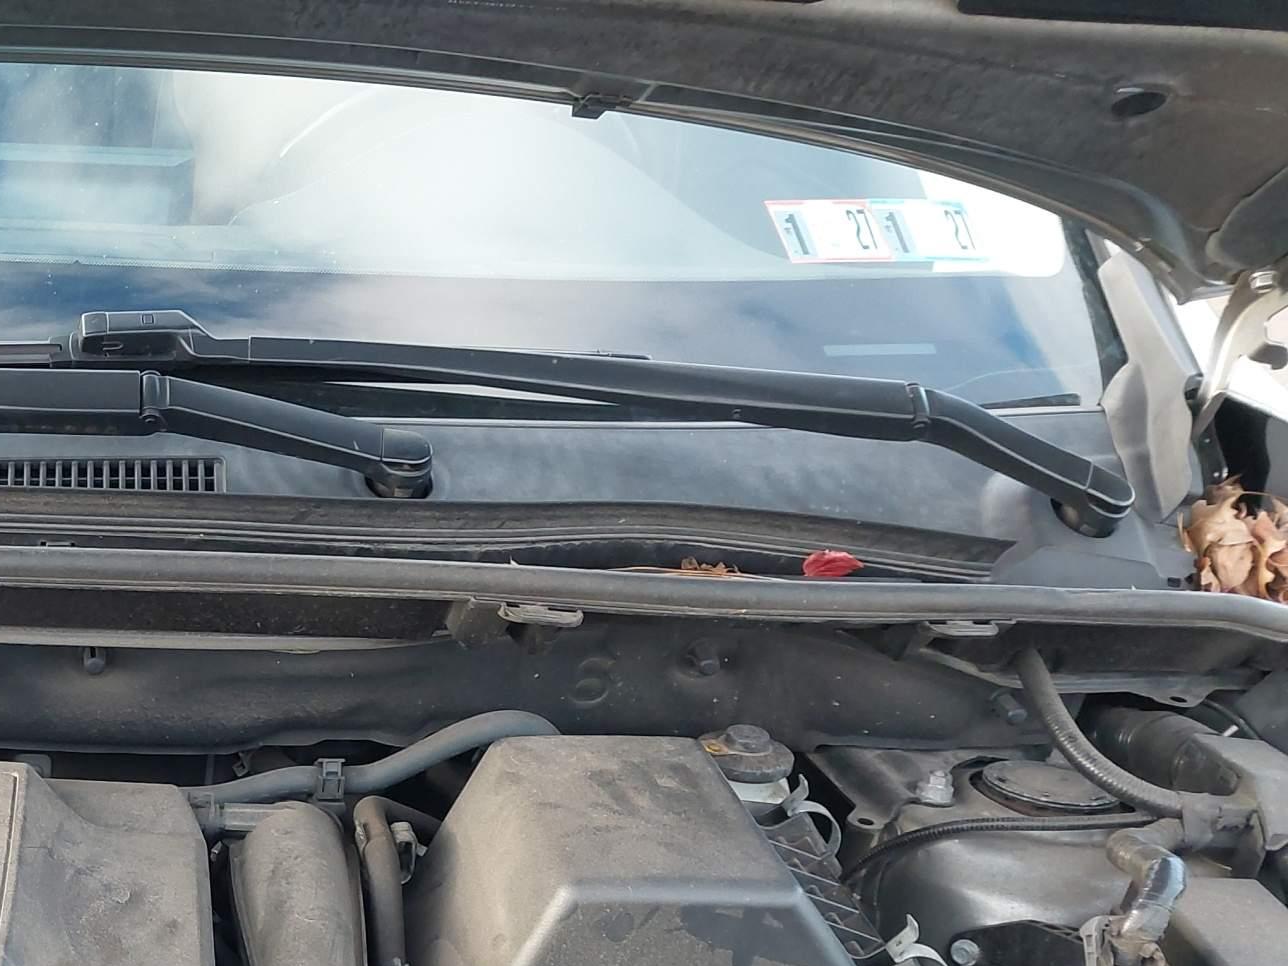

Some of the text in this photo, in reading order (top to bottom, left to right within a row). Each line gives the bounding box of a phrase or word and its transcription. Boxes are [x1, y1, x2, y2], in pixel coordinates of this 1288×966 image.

[785, 208, 878, 255] 1 27
[885, 209, 976, 253] 1 27
